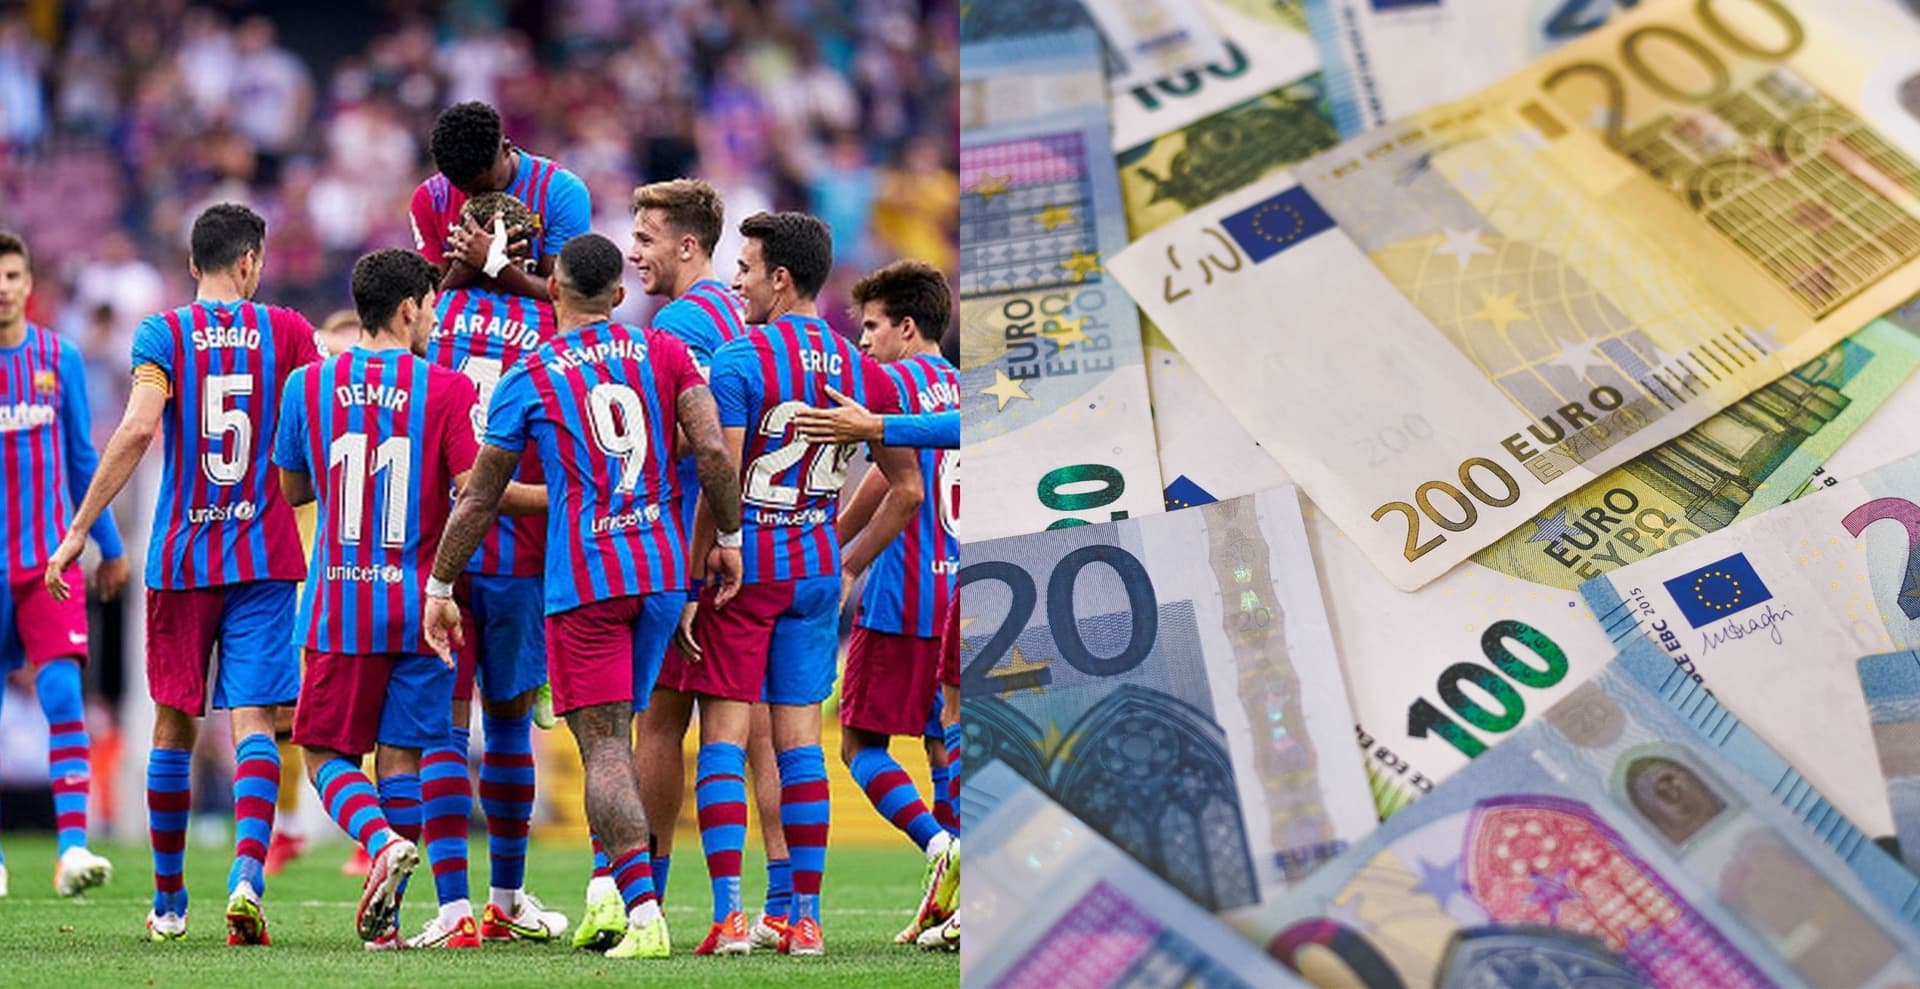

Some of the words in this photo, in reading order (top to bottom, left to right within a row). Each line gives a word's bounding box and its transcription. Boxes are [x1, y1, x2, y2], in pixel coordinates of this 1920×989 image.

[192, 326, 261, 351] SERGIO
[452, 313, 540, 351] ARAUJO
[546, 339, 648, 376] MEMPHIS
[799, 348, 843, 376] ERIC
[1003, 298, 1041, 380] EURO
[202, 373, 253, 486] 5
[336, 383, 409, 412] DEMIR
[1500, 386, 1625, 463] EURO
[585, 382, 648, 495] 9
[329, 432, 411, 548] 11
[1371, 457, 1521, 562] 200
[1543, 488, 1640, 569] EURO
[327, 561, 380, 583] unicef
[1630, 587, 1656, 617] 2015
[960, 544, 1158, 698] 20
[1652, 619, 1682, 652] EBC
[1407, 619, 1569, 759] 100
